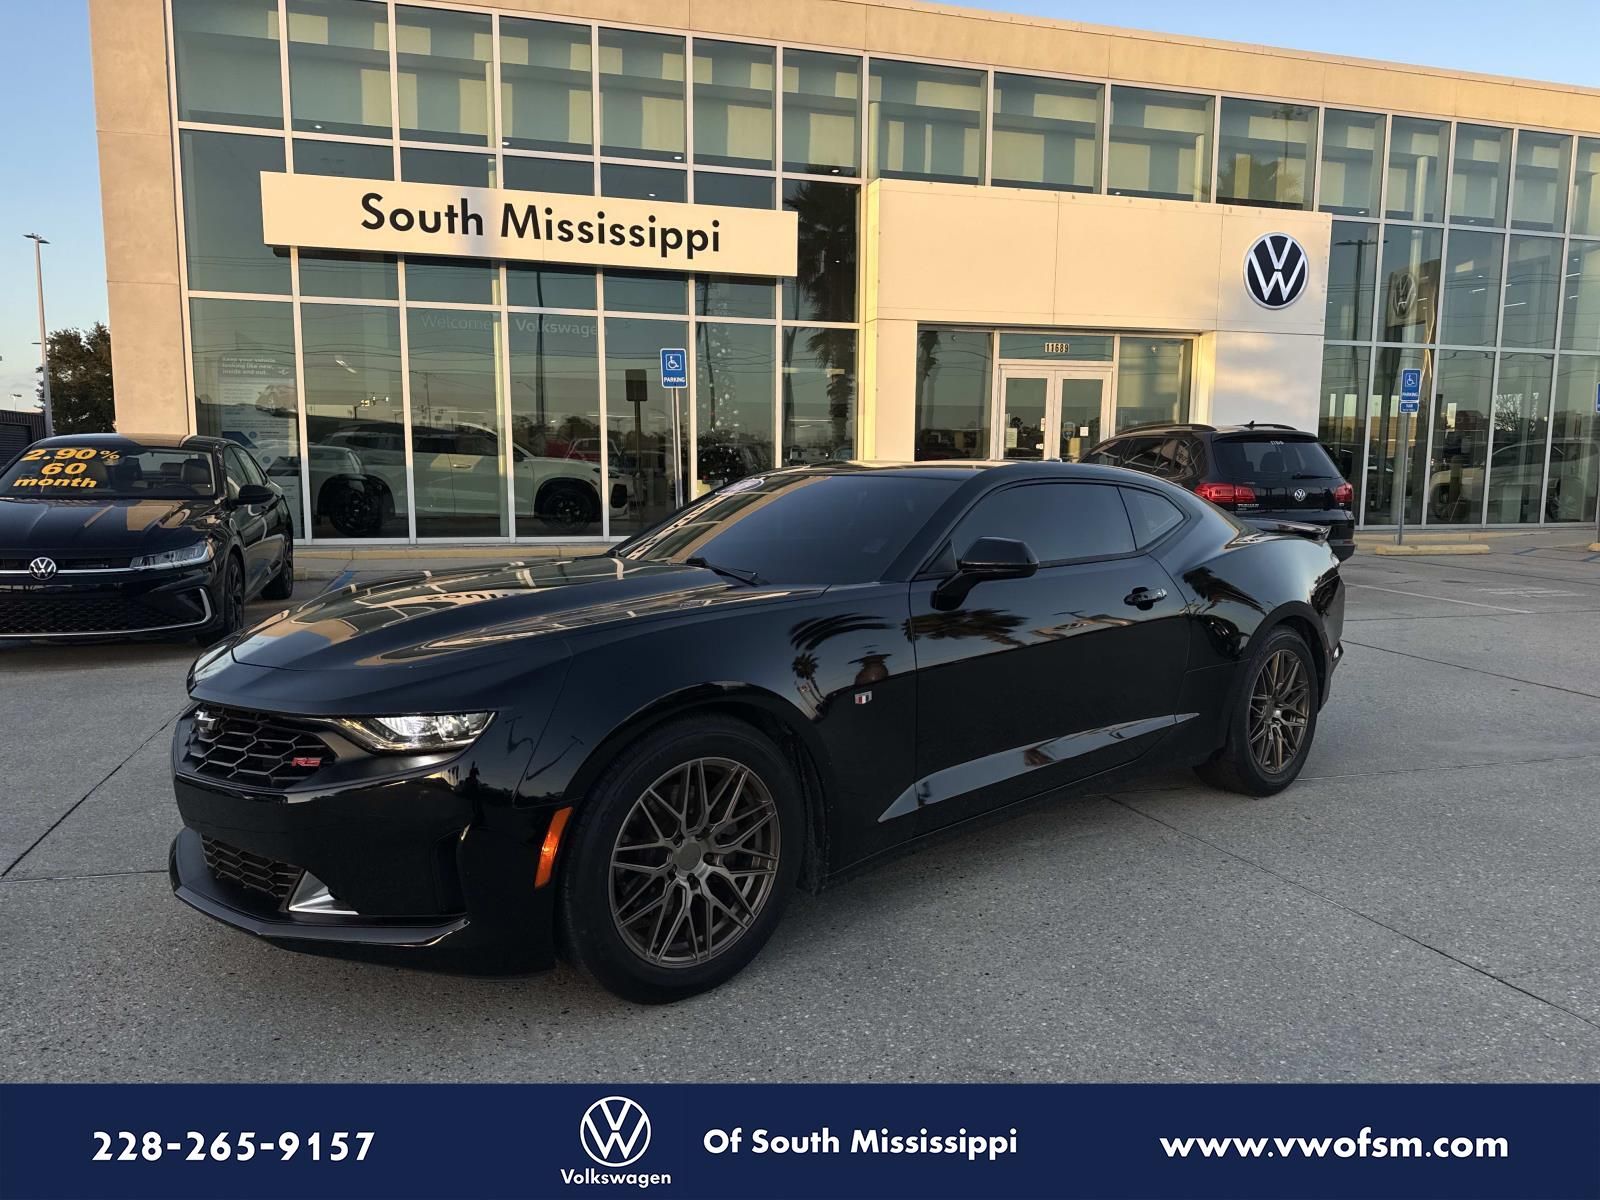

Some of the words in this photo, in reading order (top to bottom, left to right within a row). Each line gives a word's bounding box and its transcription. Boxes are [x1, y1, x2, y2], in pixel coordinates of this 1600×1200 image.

[361, 192, 484, 236] South
[501, 203, 720, 260] Mississippi
[422, 313, 492, 330] Welcome
[20, 448, 120, 462] 2.90%
[41, 462, 87, 475] 60
[13, 477, 97, 488] month
[291, 757, 322, 767] RS
